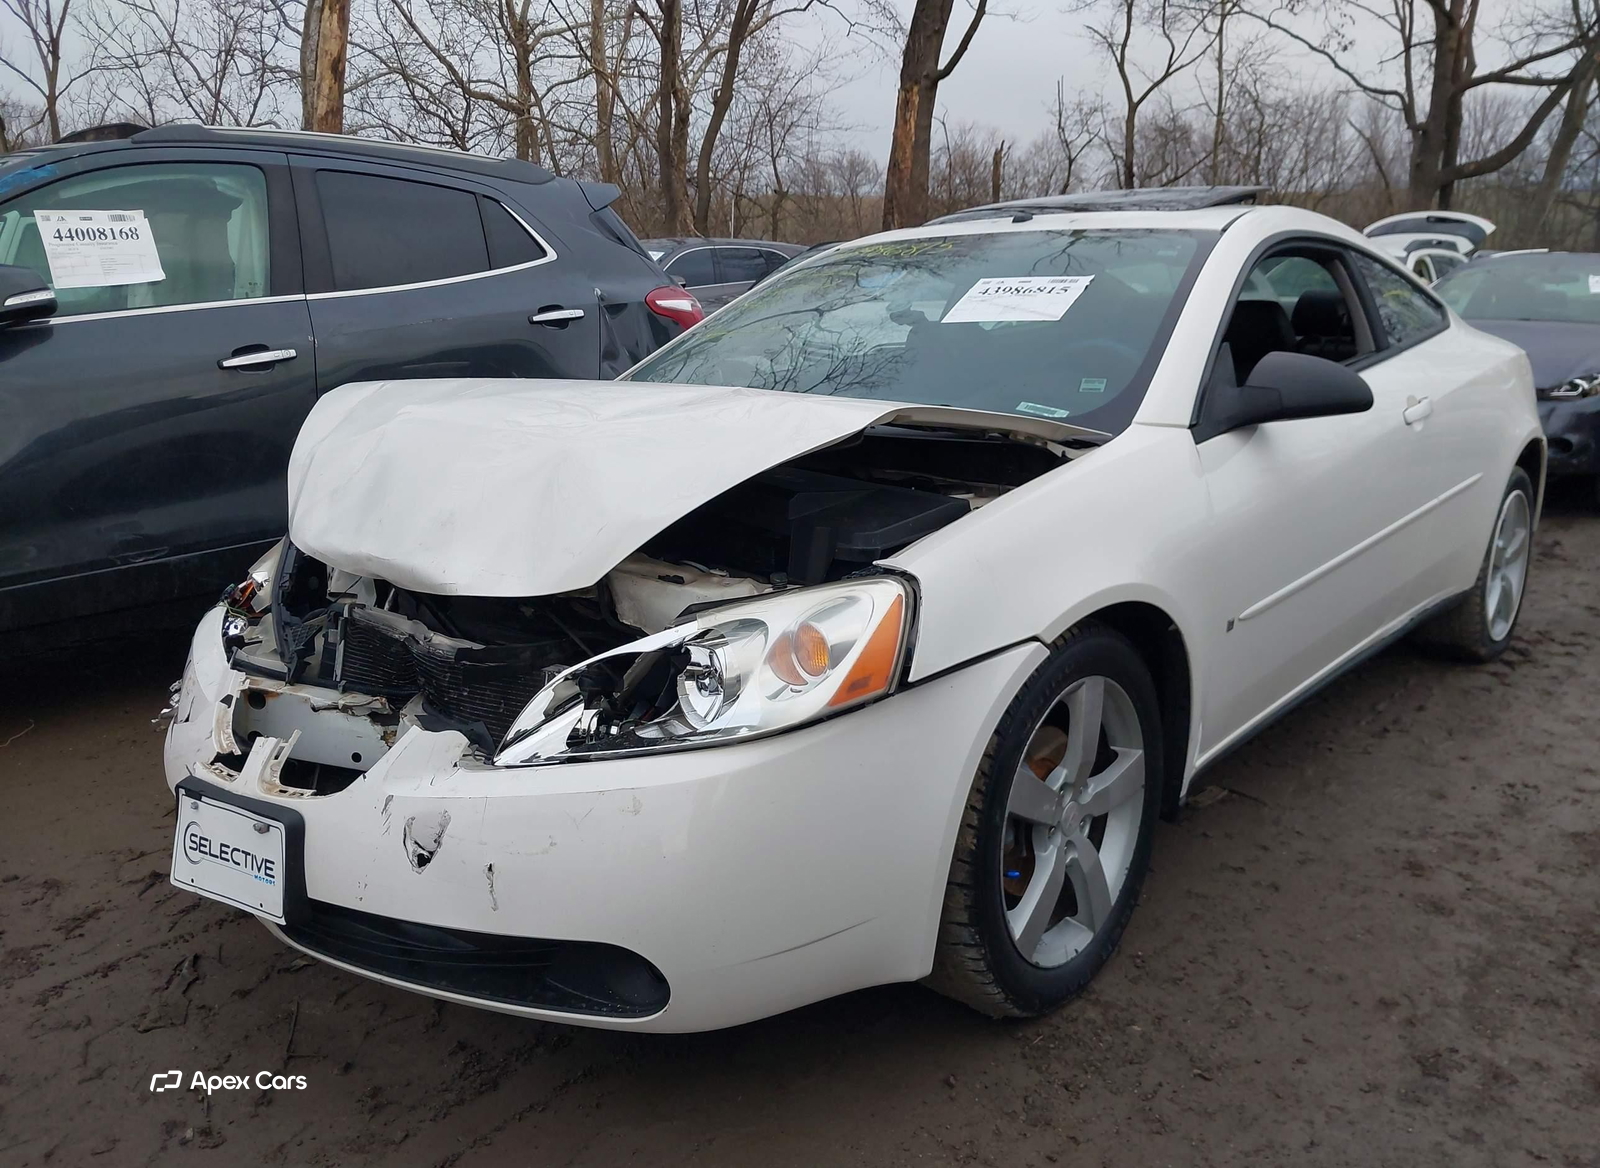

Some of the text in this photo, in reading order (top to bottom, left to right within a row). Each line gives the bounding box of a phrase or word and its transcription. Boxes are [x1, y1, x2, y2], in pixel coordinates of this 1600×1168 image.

[53, 226, 140, 242] 44008168
[977, 285, 1071, 296] 43986815
[188, 832, 276, 879] SELECTIVE
[253, 874, 276, 886] MOTORS
